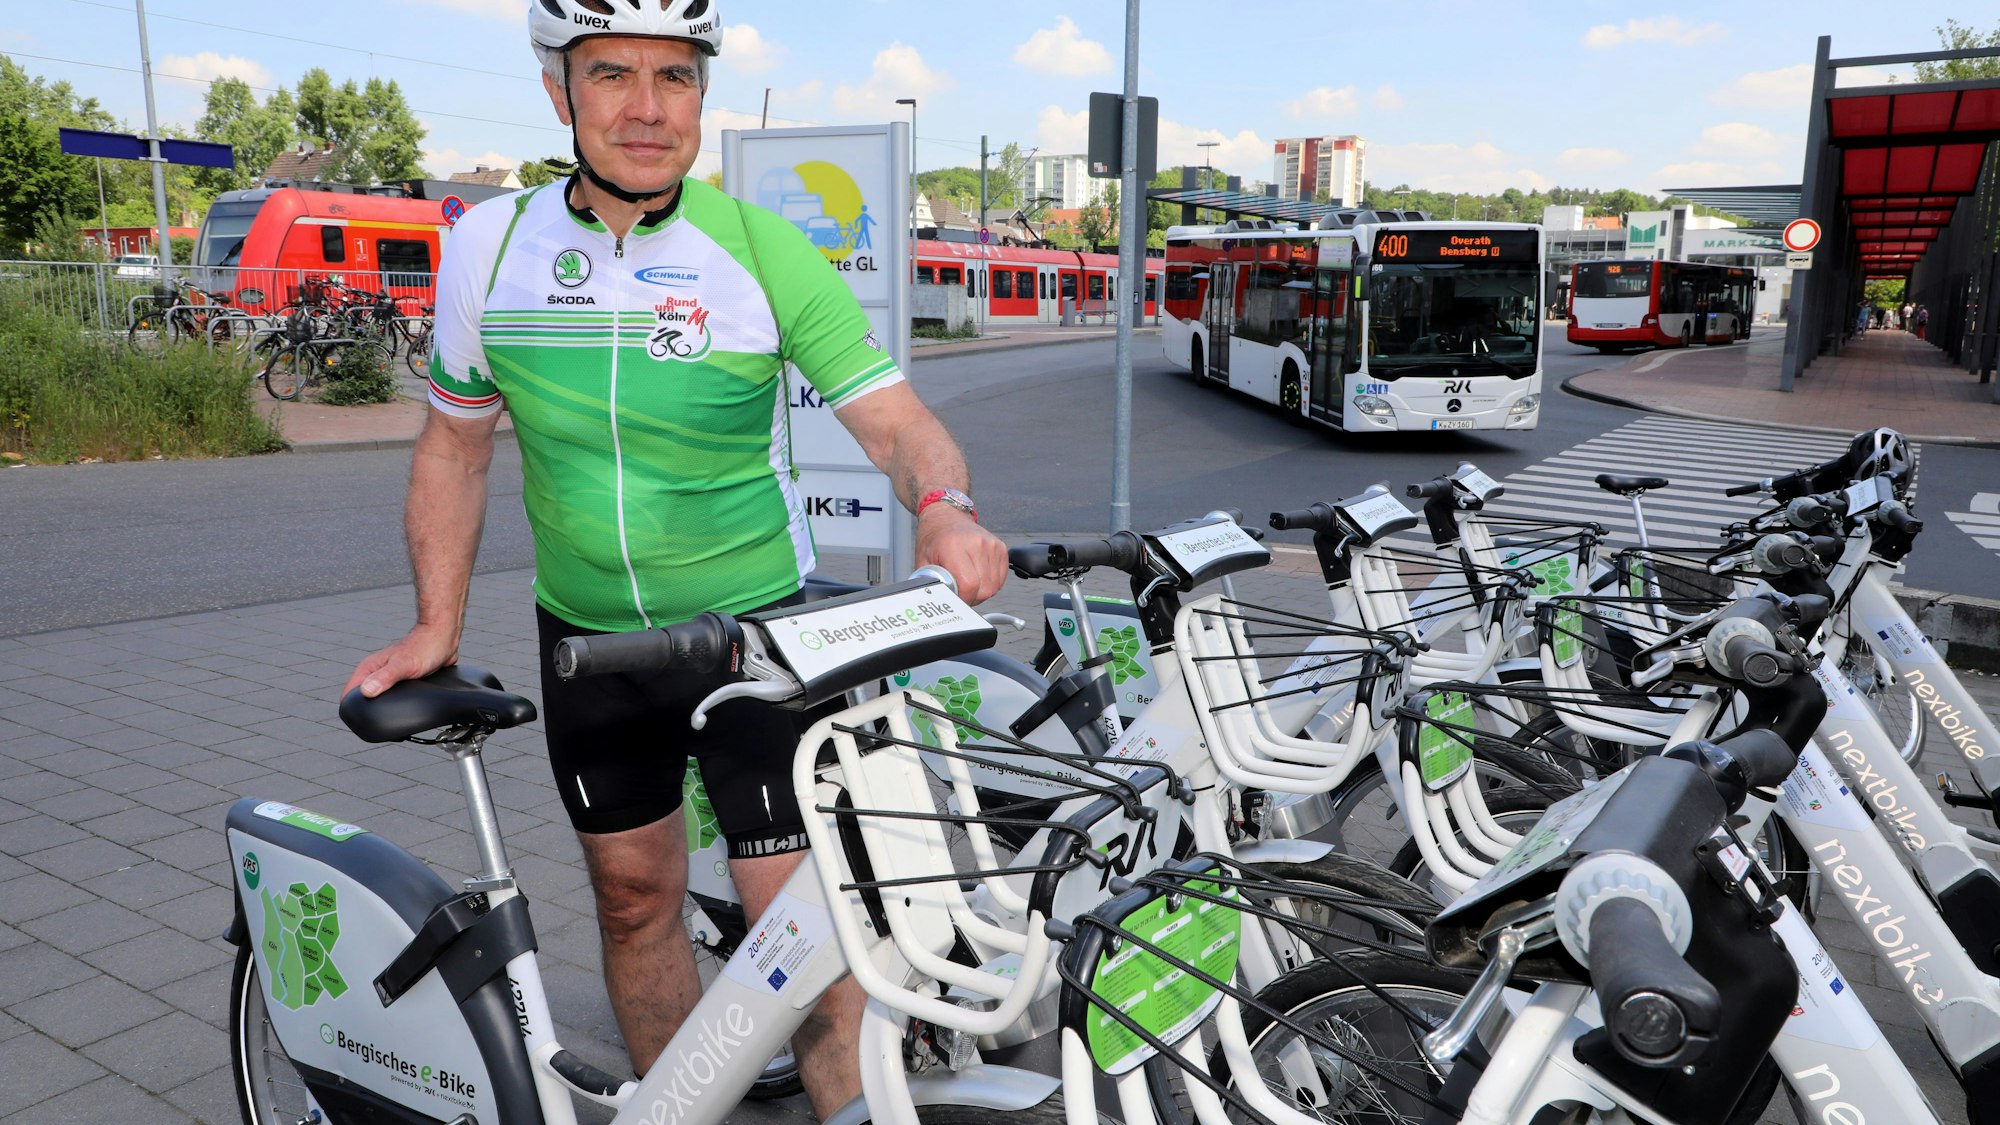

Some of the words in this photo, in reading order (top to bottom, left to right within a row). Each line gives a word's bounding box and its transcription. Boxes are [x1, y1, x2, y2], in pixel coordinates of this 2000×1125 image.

[574, 13, 611, 30] uvex
[689, 21, 713, 35] uvex
[1378, 235, 1408, 257] 400
[1451, 236, 1491, 245] Overath
[1440, 247, 1487, 257] Bensberg
[856, 256, 878, 271] GL
[646, 271, 700, 281] SCHWALBE
[547, 294, 596, 305] ŠKODA
[666, 297, 697, 308] Rund
[655, 304, 674, 312] um
[659, 311, 686, 322] Köln
[1183, 537, 1223, 553] Bergisches
[818, 612, 908, 645] Bergisches
[904, 601, 955, 623] e-Bike
[1904, 669, 1985, 760] nextbike
[1828, 729, 1926, 852] nextbike
[243, 855, 257, 873] VRS
[337, 1030, 417, 1078] Bergisches
[420, 1065, 475, 1099] e-Bike
[390, 1074, 414, 1088] powered
